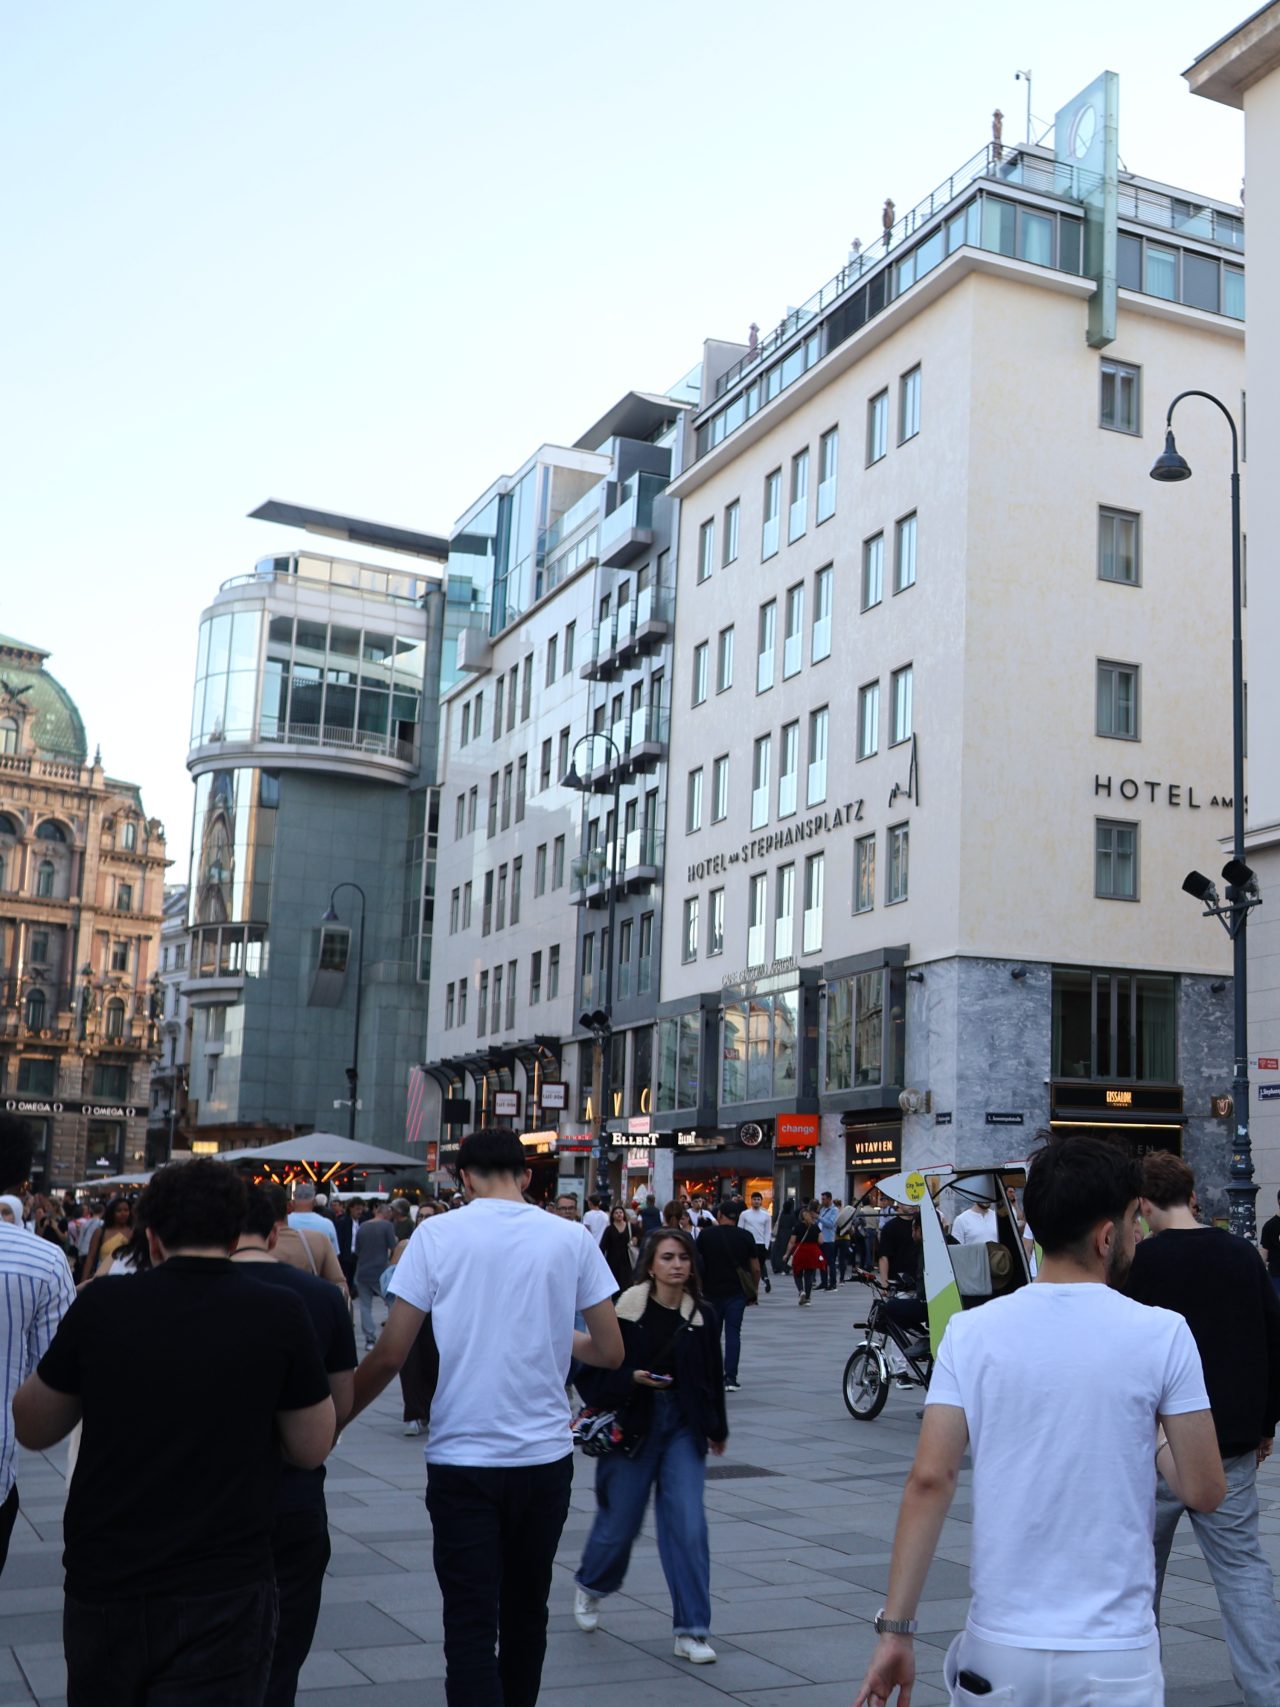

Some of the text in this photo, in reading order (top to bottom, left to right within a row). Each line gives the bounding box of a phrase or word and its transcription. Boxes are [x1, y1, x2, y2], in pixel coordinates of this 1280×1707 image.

[1094, 774, 1201, 808] HOTEL
[1210, 795, 1233, 808] AM
[687, 798, 865, 883] HOTEL AM STEPHANSPLATZ
[18, 1101, 50, 1112] OMEGA
[93, 1106, 124, 1116] OMEGA
[781, 1123, 815, 1135] change
[612, 1131, 660, 1146] ELLERT
[855, 1140, 893, 1154] VITAVIEN
